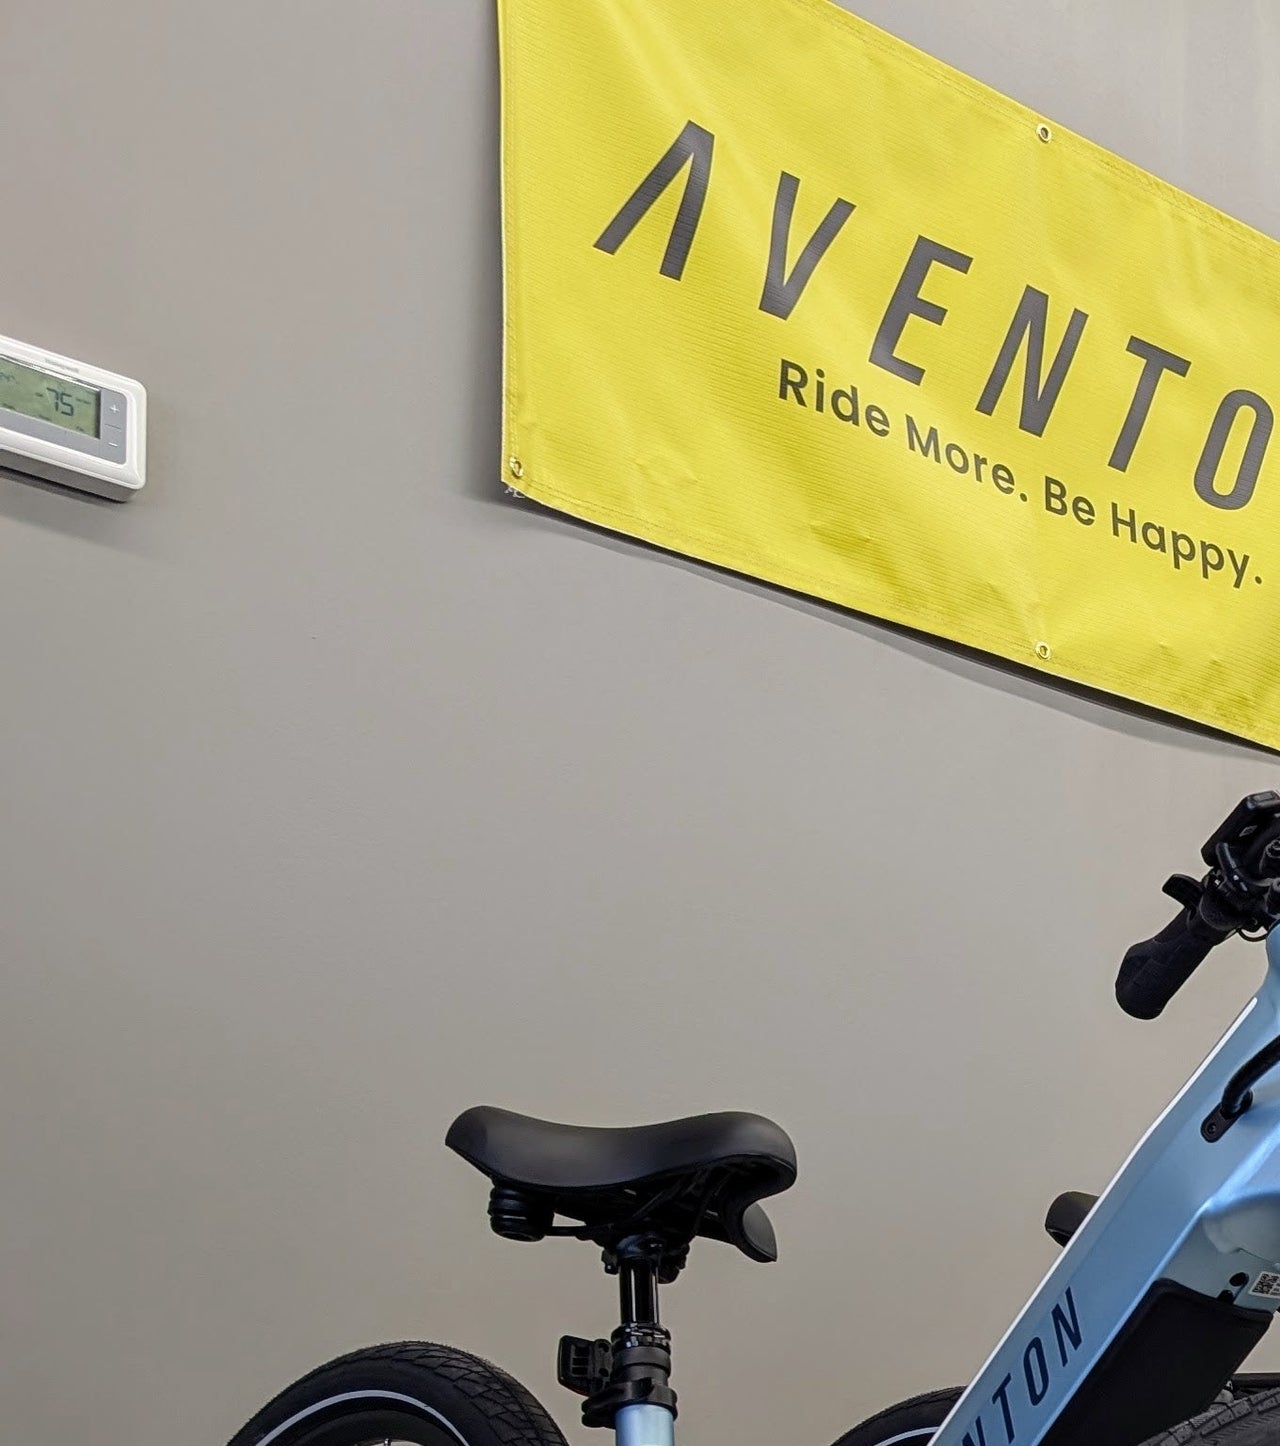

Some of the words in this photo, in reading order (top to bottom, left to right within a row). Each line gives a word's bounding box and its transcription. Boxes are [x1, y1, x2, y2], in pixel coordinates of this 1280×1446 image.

[46, 387, 74, 416] 75
[779, 358, 890, 438] Ride
[906, 414, 1028, 502] More.
[1044, 479, 1097, 527] Be
[1110, 502, 1264, 590] Happy.
